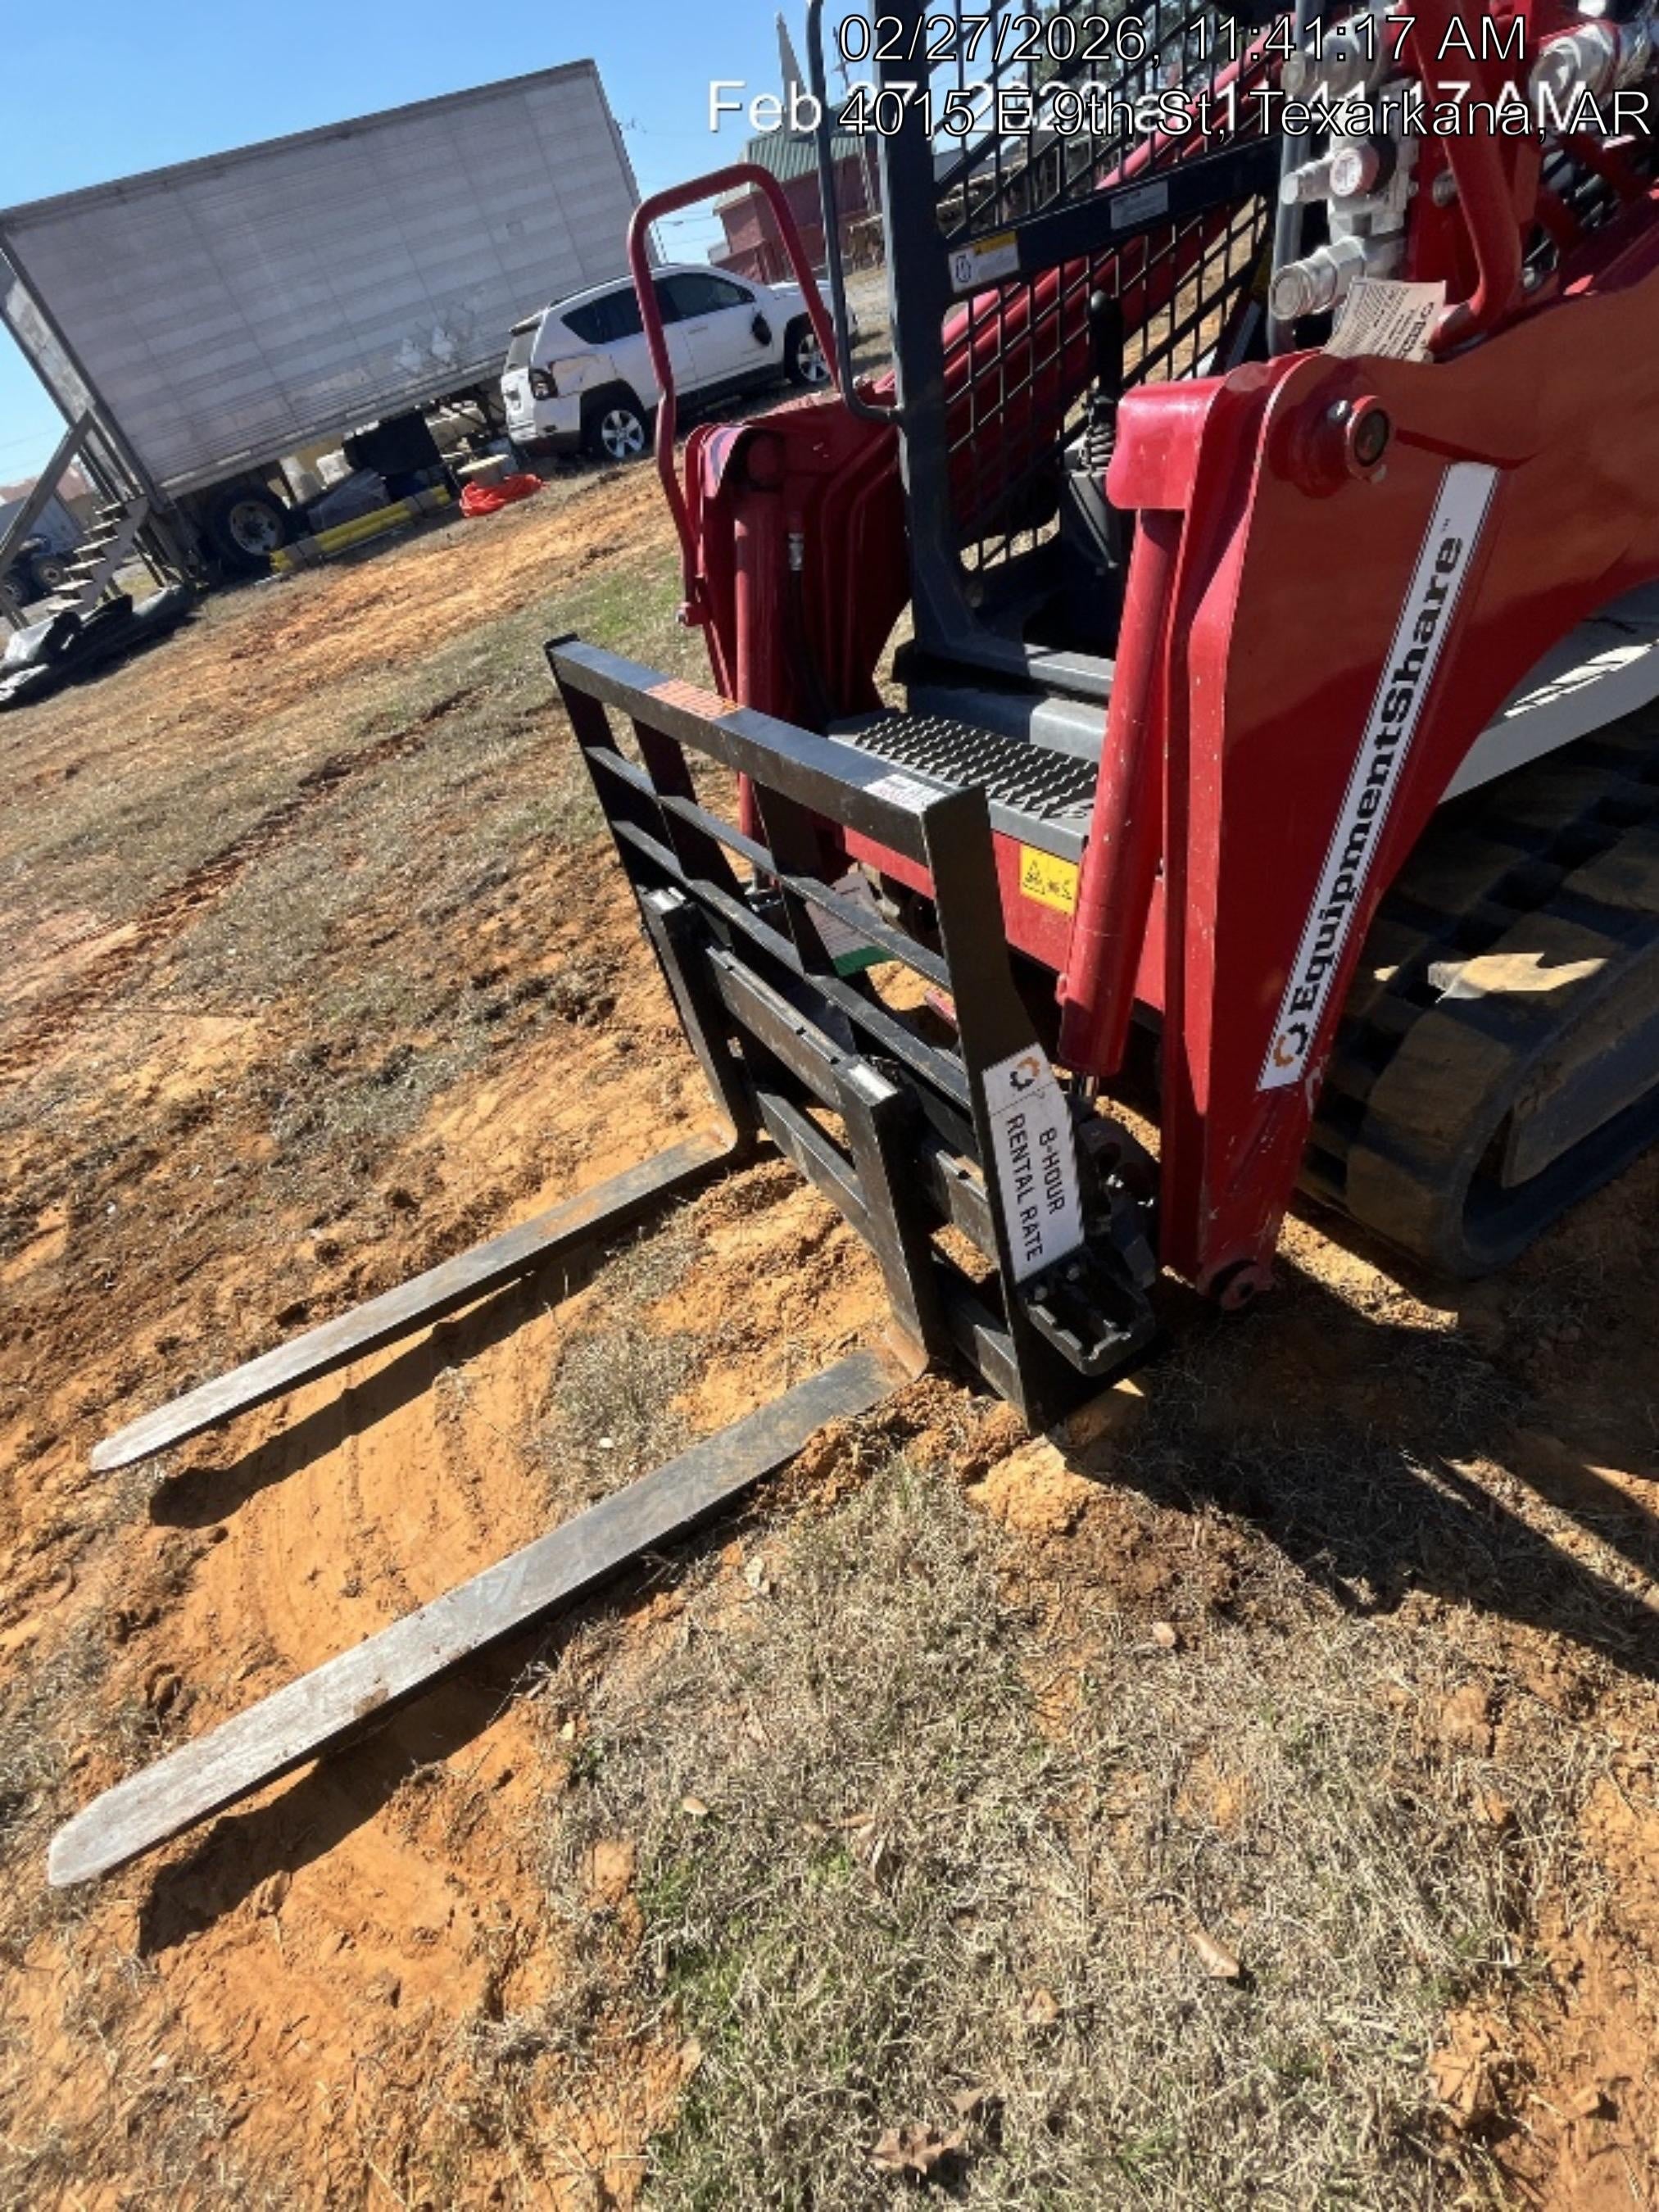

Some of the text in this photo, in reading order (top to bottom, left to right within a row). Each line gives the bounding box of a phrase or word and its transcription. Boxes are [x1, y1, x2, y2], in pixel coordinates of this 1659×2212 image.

[1290, 537, 1462, 1016] EquipmentShare
[1006, 1112, 1044, 1262] RENTAL RATE
[1039, 1126, 1065, 1215] 8-HOUR
